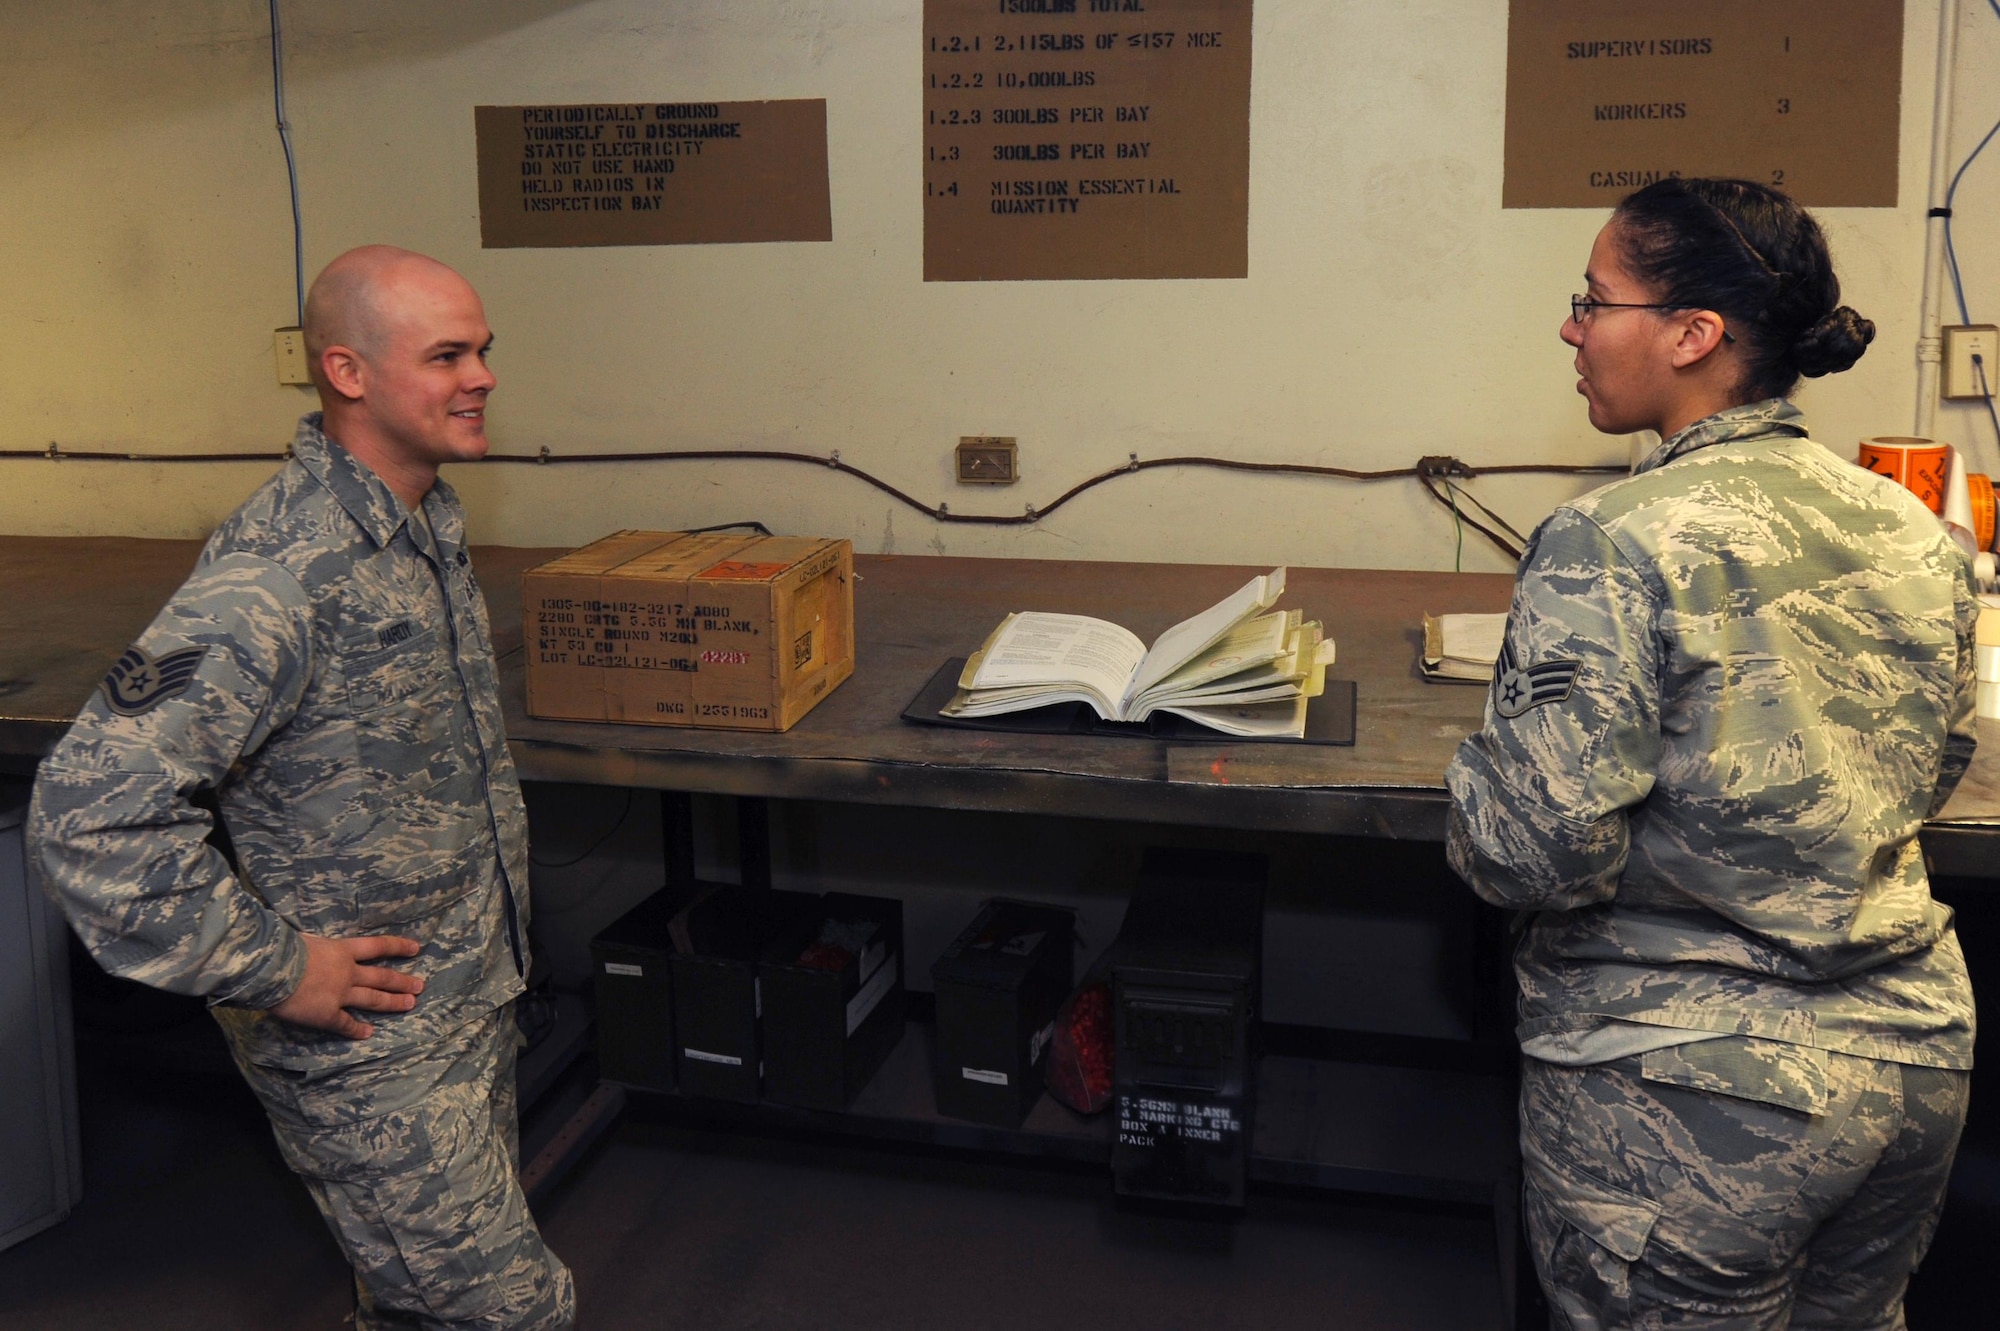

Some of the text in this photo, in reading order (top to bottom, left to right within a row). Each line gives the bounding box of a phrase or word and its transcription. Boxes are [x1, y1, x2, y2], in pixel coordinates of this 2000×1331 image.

[1089, 0, 1144, 12] TOTAL
[931, 35, 980, 52] 1.2.1
[994, 34, 1084, 51] 2,115LBS
[1096, 33, 1118, 49] OF
[1187, 32, 1222, 47] MCE
[1567, 36, 1790, 59] SUPERVISORS 1
[931, 71, 1095, 88] 1.2.2 10,000LBS
[523, 104, 719, 123] PERIODICALLY GROUND
[930, 106, 1149, 125] 1.2.3 300LBS PER BAY
[1594, 98, 1790, 121] WORKERS 3
[524, 122, 742, 141] YOURSELF TO DISCHARGE
[525, 140, 704, 158] STATIC ELECTRICITY
[930, 142, 1150, 161] 1.3 300LBS PER BAY
[521, 158, 675, 176] DO NOT USE HAND
[522, 176, 665, 194] HELD RADIOS IN
[1771, 169, 1784, 186] 2
[928, 178, 1181, 196] 1.4 MISSION ESSENTIAL
[523, 195, 662, 212] INSPECTION BAY
[991, 198, 1079, 214] QUANTITY
[675, 617, 697, 630] MM
[540, 626, 595, 638] SINGLE
[604, 629, 650, 641] ROUND
[540, 652, 568, 664] LOT
[656, 702, 768, 719] DWG 12551963
[1140, 1111, 1202, 1127] MARKING
[1183, 1104, 1231, 1119] BLANK
[1121, 1120, 1148, 1132] BOX
[1178, 1127, 1220, 1141] INNER
[1120, 1134, 1155, 1147] PACK
